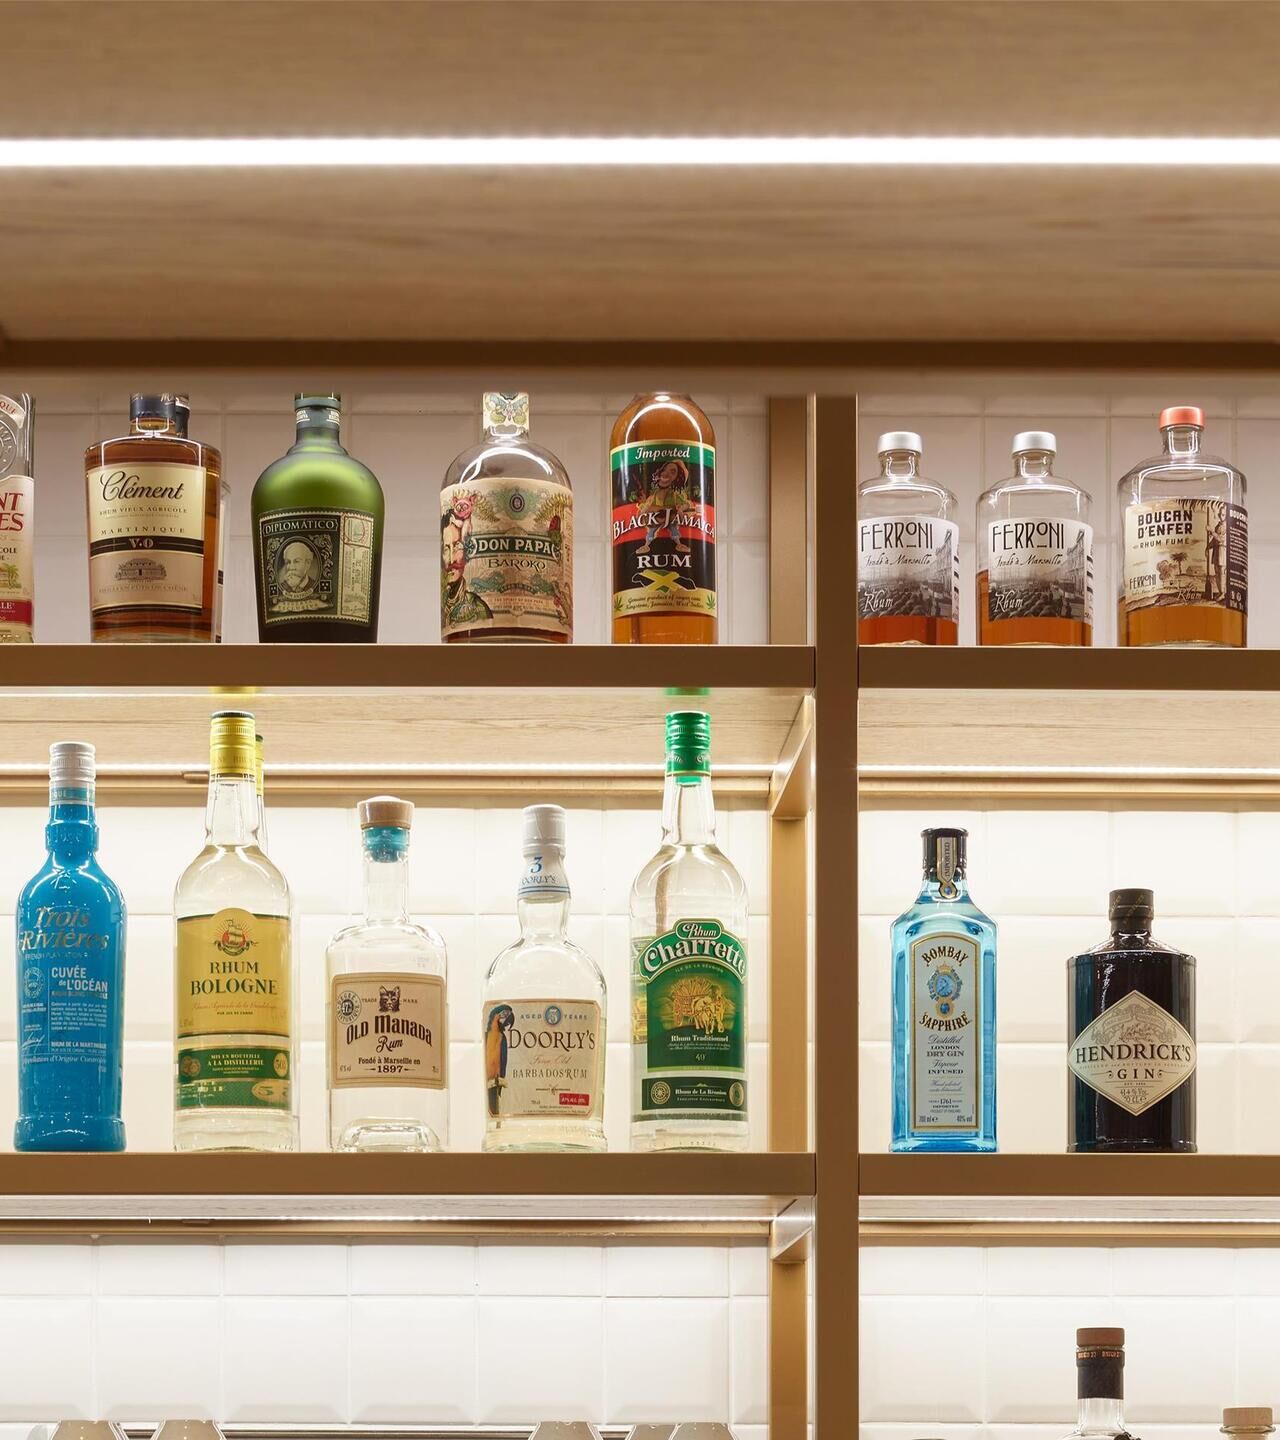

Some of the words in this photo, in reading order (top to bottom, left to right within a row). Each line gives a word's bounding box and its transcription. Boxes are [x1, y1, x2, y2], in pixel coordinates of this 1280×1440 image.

[634, 446, 691, 464] Imported
[99, 471, 186, 502] Clément
[613, 511, 661, 540] BLACK
[1137, 509, 1194, 527] BOUCAN
[99, 531, 186, 541] MARTINIQUE
[860, 521, 934, 554] FERRONI
[992, 522, 1065, 554] FERRONI
[1137, 522, 1194, 539] D'ENFER
[478, 538, 510, 551] DON
[515, 536, 553, 554] PAPA
[1139, 539, 1162, 549] RHUM
[487, 557, 547, 573] BAROKO
[635, 554, 693, 570] RUM
[34, 906, 91, 929] Trois
[682, 922, 718, 939] Rhum
[643, 937, 746, 973] Charrette
[921, 945, 969, 967] BOMBAY
[51, 964, 87, 979] CUVÉE
[208, 962, 259, 974] RHUM
[190, 979, 280, 997] BOLOGNE
[563, 1013, 589, 1021] YEARS
[918, 1012, 972, 1032] SAPPHIRE
[346, 1020, 370, 1046] OLD
[508, 1028, 596, 1053] DOORLY'S
[671, 1034, 691, 1043] Rhum
[375, 1035, 404, 1054] Rum
[1075, 1043, 1192, 1064] HENDRICK'S
[357, 1056, 377, 1065] Fondé
[383, 1056, 413, 1065] Marseille
[376, 1065, 404, 1074] 1897
[512, 1068, 564, 1080] BARBADOS
[1117, 1068, 1155, 1080] GIN
